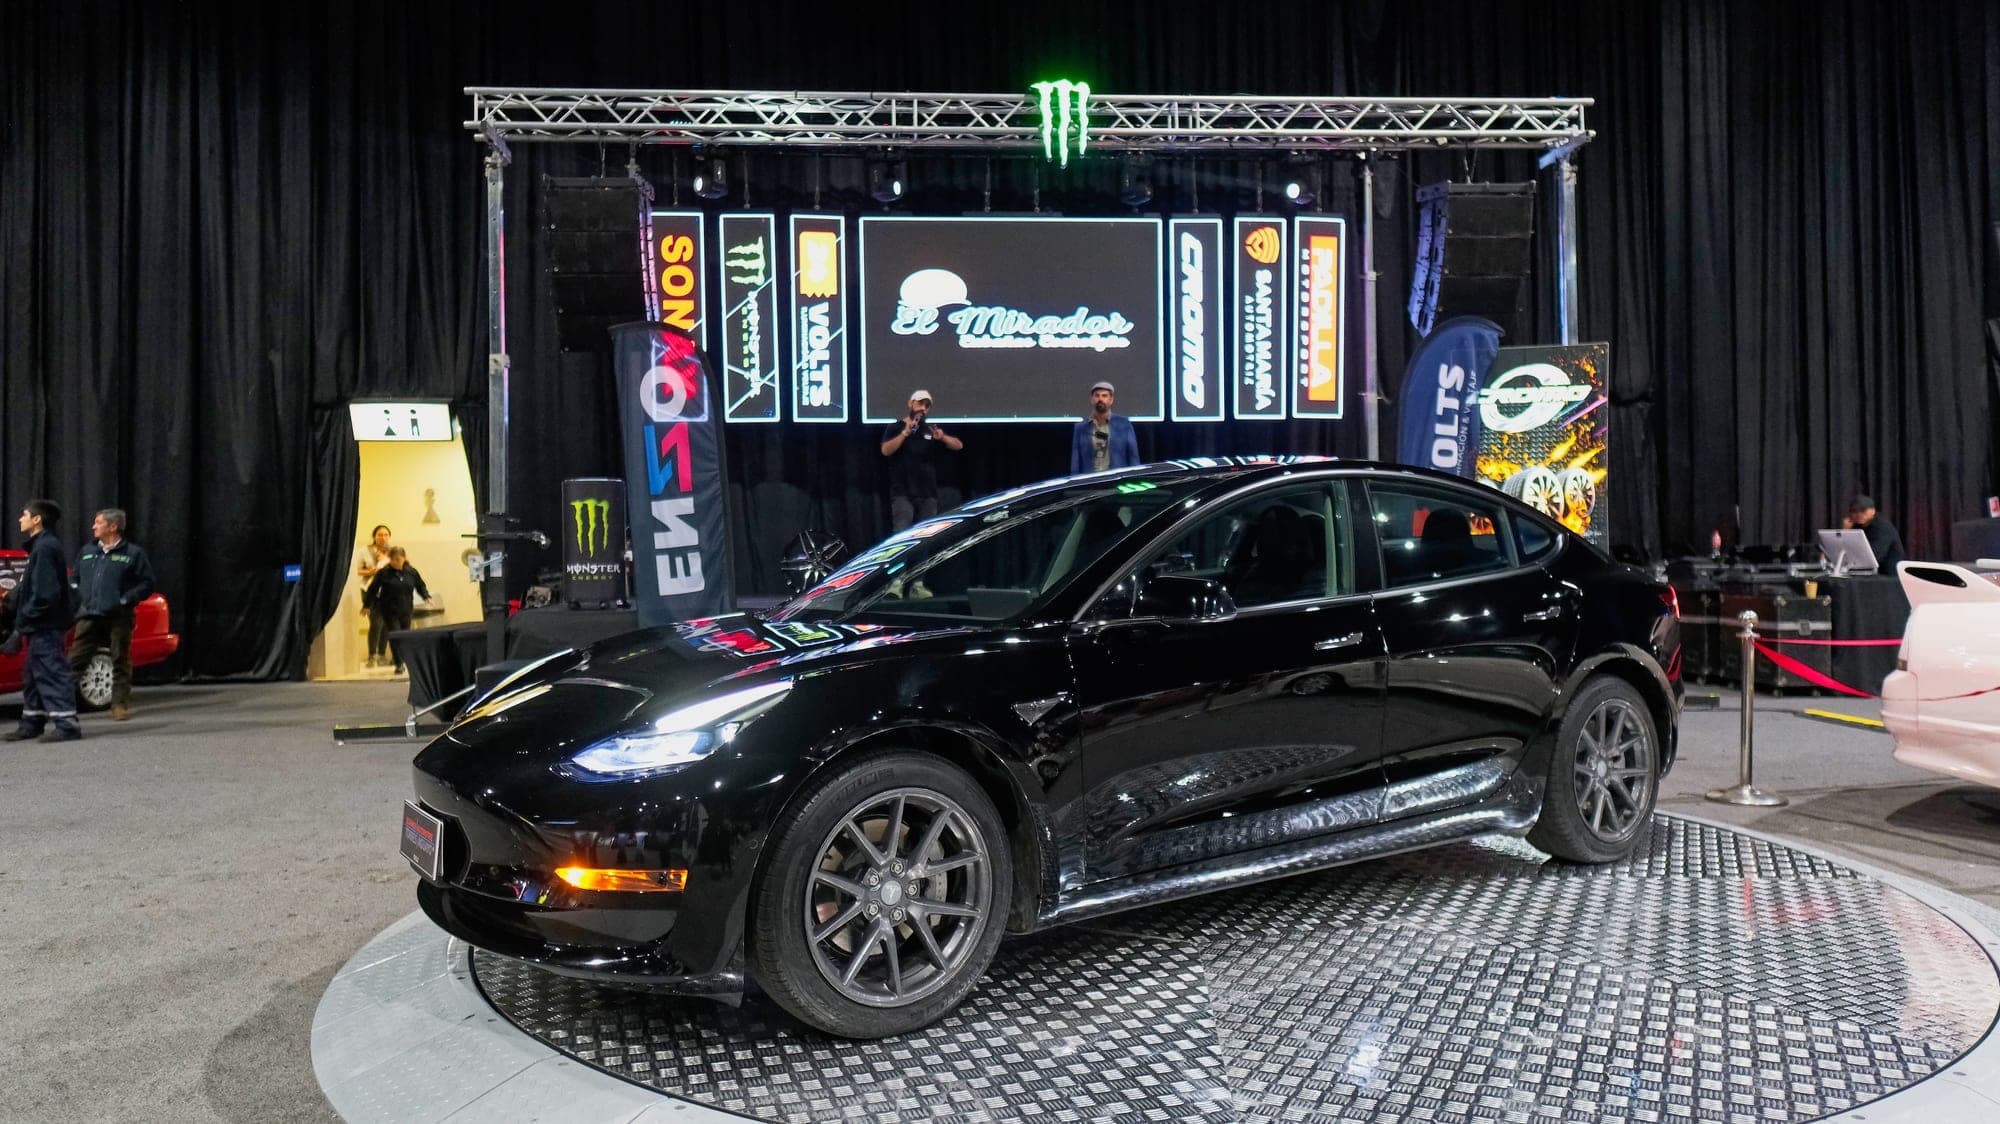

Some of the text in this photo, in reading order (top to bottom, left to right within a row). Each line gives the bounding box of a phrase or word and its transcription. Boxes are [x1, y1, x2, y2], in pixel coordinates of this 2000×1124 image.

[746, 290, 761, 398] MONSTER
[809, 302, 831, 407] VOLTS
[891, 305, 1135, 337] El Mirador
[1181, 231, 1204, 409] CROMO
[1243, 295, 1254, 386] AUTOMOTRIZ
[1255, 269, 1276, 411] SANTAMARÍA
[1300, 248, 1310, 388] MOTORSPORT
[1311, 247, 1333, 388] PADILLA
[1431, 363, 1465, 470] OLTS
[566, 563, 621, 575] MONSTER
